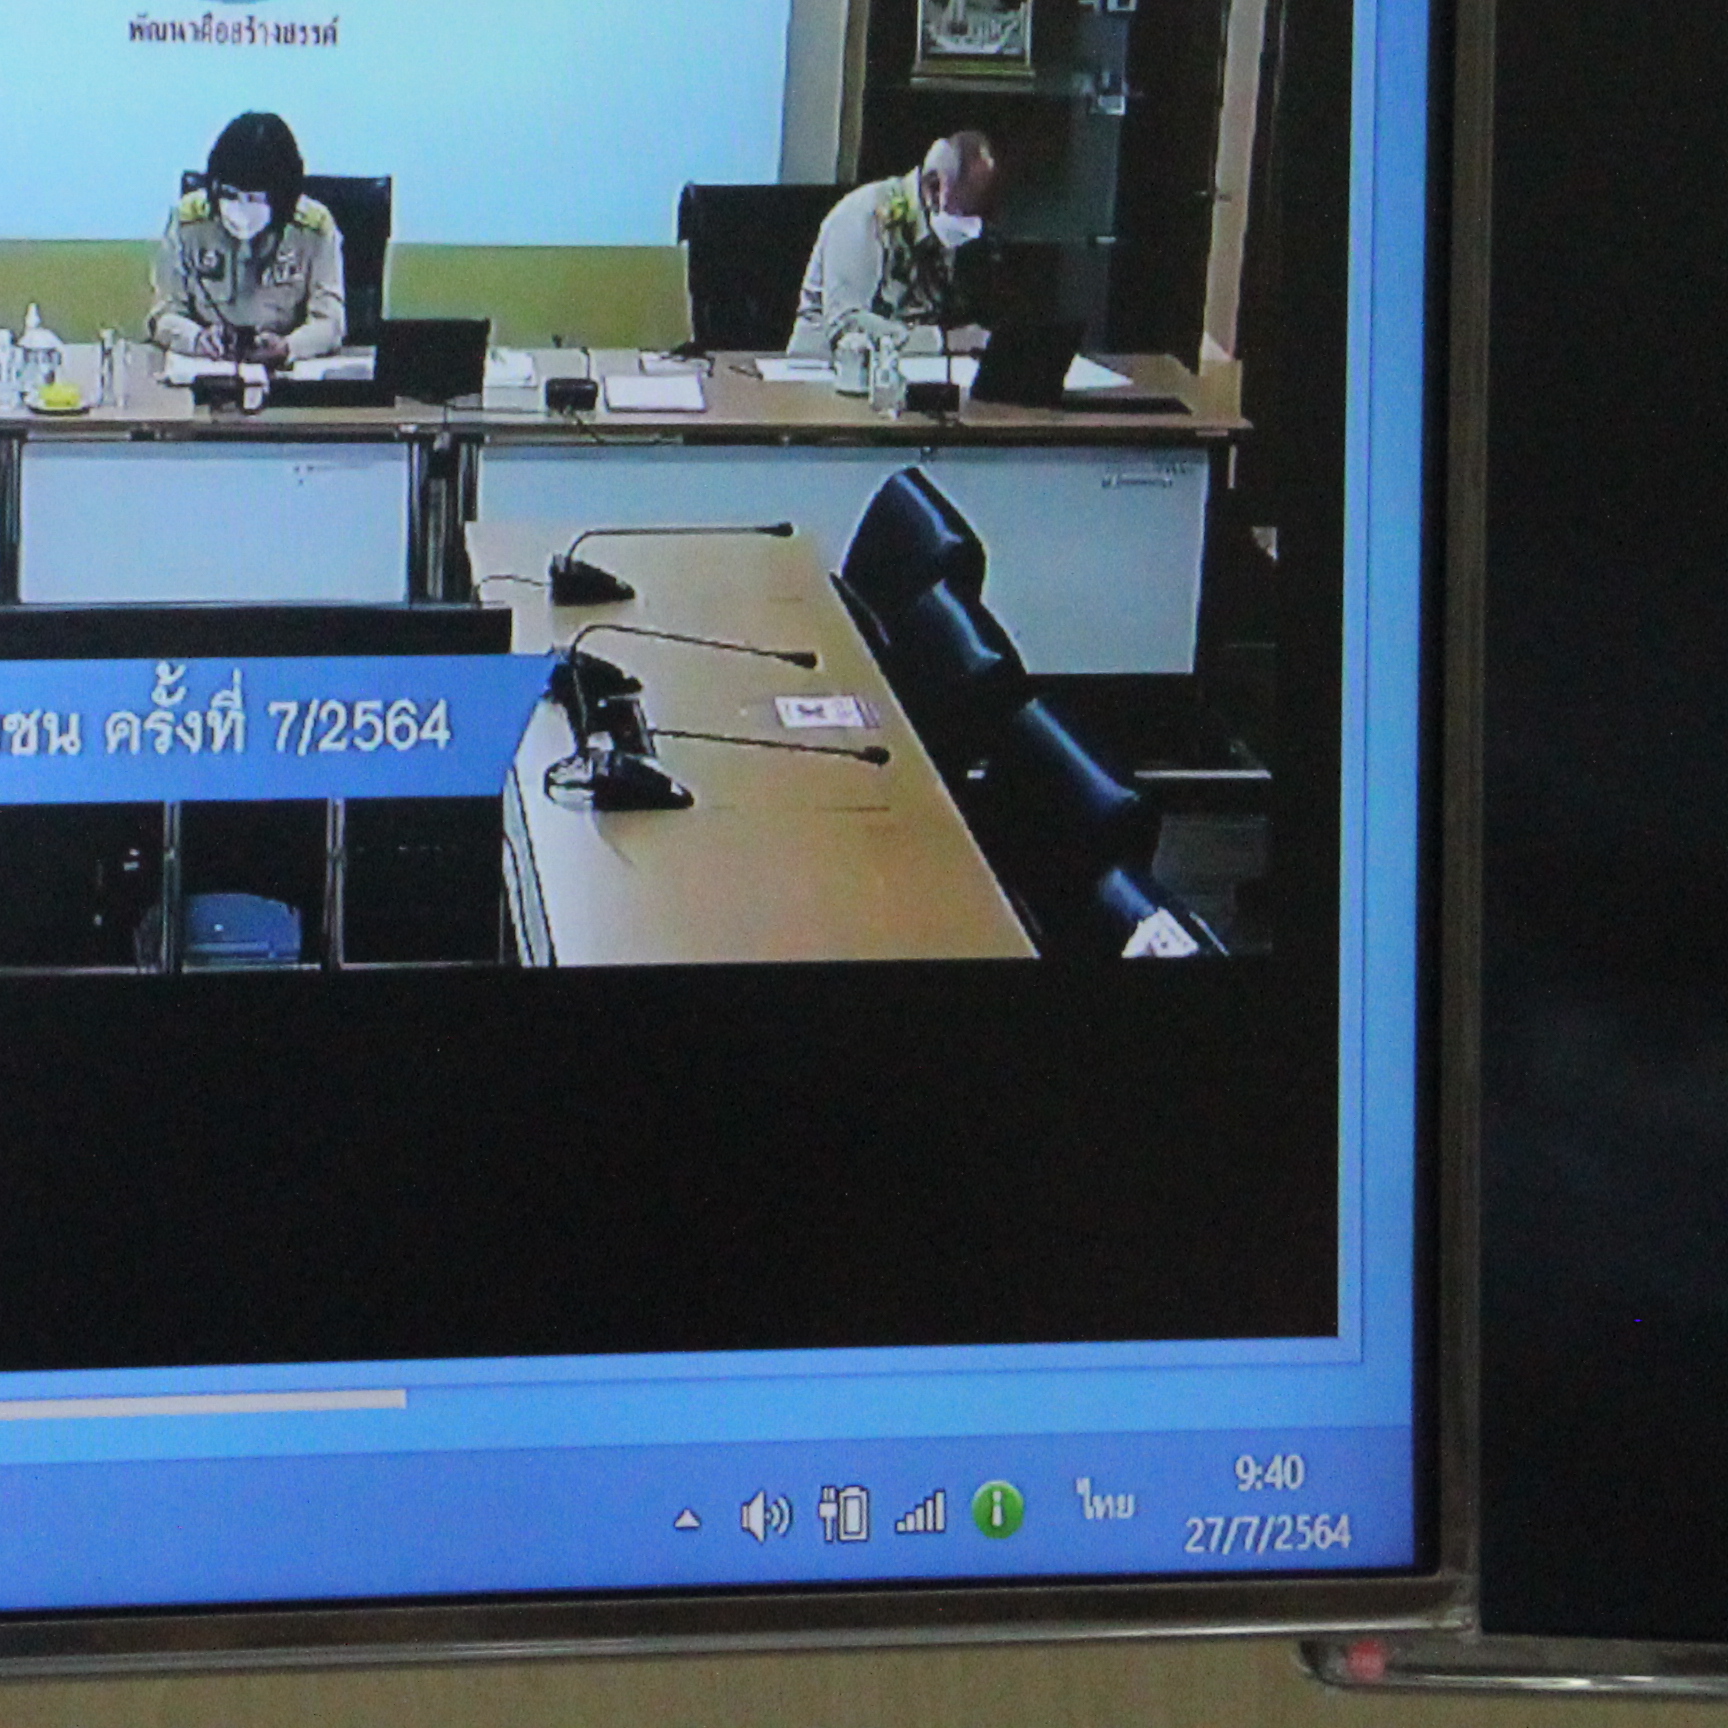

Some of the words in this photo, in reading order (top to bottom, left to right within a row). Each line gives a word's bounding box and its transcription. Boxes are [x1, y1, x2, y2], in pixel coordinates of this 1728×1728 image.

[105, 660, 247, 756] ครั้งที่
[267, 698, 451, 756] 7/2564
[1235, 1454, 1304, 1492] 9:40
[1077, 1477, 1136, 1522] ไทย
[1184, 1512, 1352, 1555] 27/7/2564
